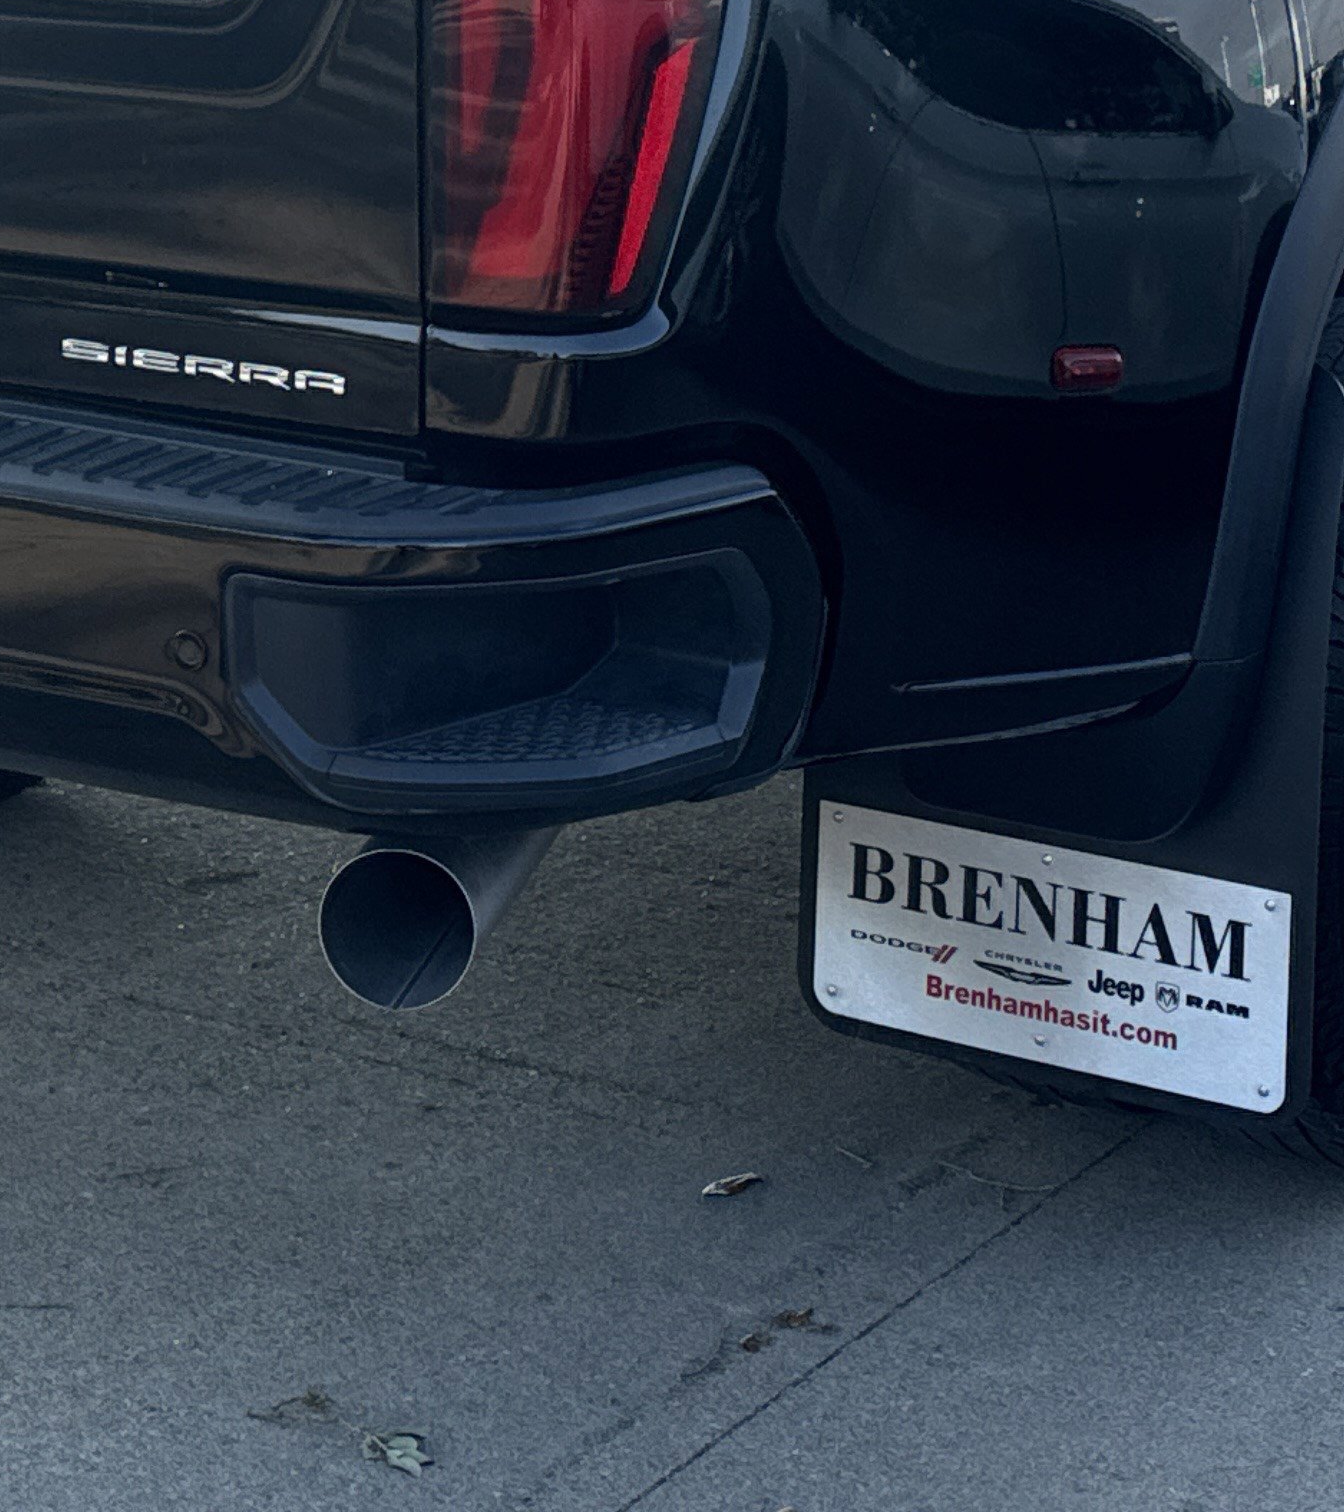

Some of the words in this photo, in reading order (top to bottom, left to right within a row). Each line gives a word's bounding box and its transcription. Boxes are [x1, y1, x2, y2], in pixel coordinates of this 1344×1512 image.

[61, 338, 346, 395] SIERRA
[848, 841, 1253, 982] BRENHAM
[850, 928, 941, 956] DODGE
[984, 949, 1063, 972] CHRYSLER
[1087, 969, 1145, 1006] Jeep
[925, 974, 1178, 1050] Brenhamhasit.com
[1185, 994, 1250, 1019] RAM
